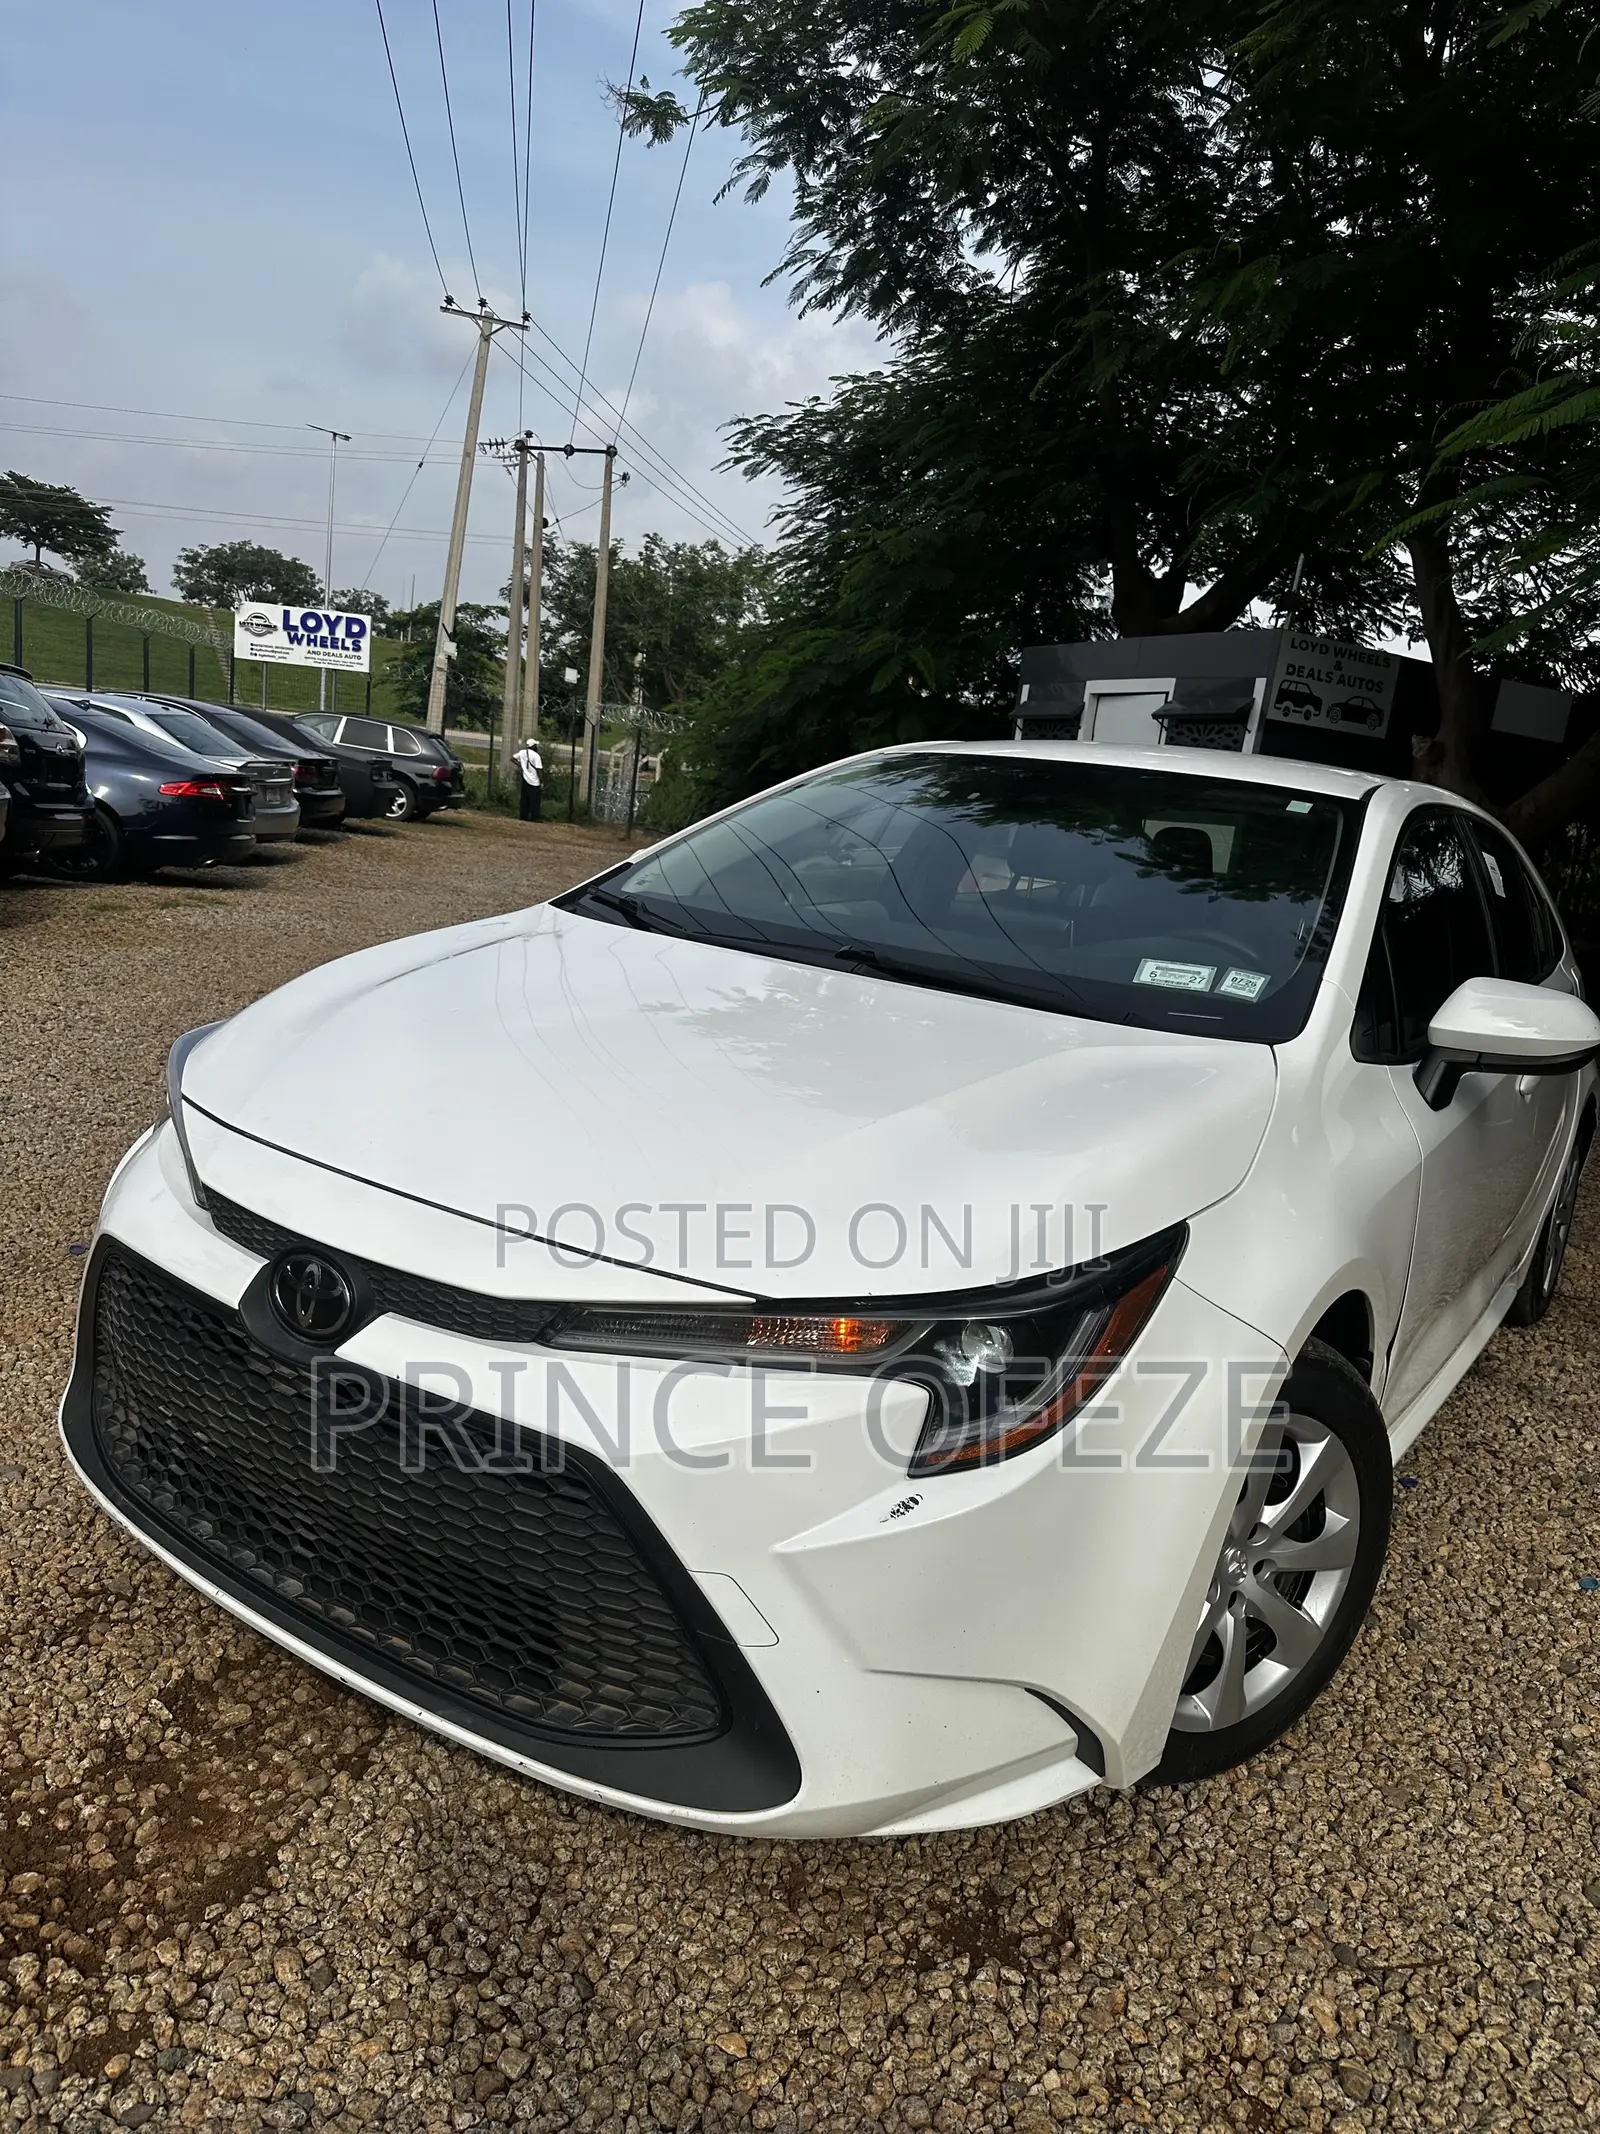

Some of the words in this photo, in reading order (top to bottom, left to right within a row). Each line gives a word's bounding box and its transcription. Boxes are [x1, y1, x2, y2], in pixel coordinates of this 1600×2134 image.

[282, 609, 367, 639] LOYD
[287, 632, 362, 652] WHEELS
[1290, 638, 1329, 655] LOYD
[1333, 646, 1391, 668] WHEELS
[1333, 660, 1343, 671] &
[1285, 663, 1334, 684] DEALS
[1336, 674, 1384, 694] AUTOS
[1188, 975, 1206, 984] 27
